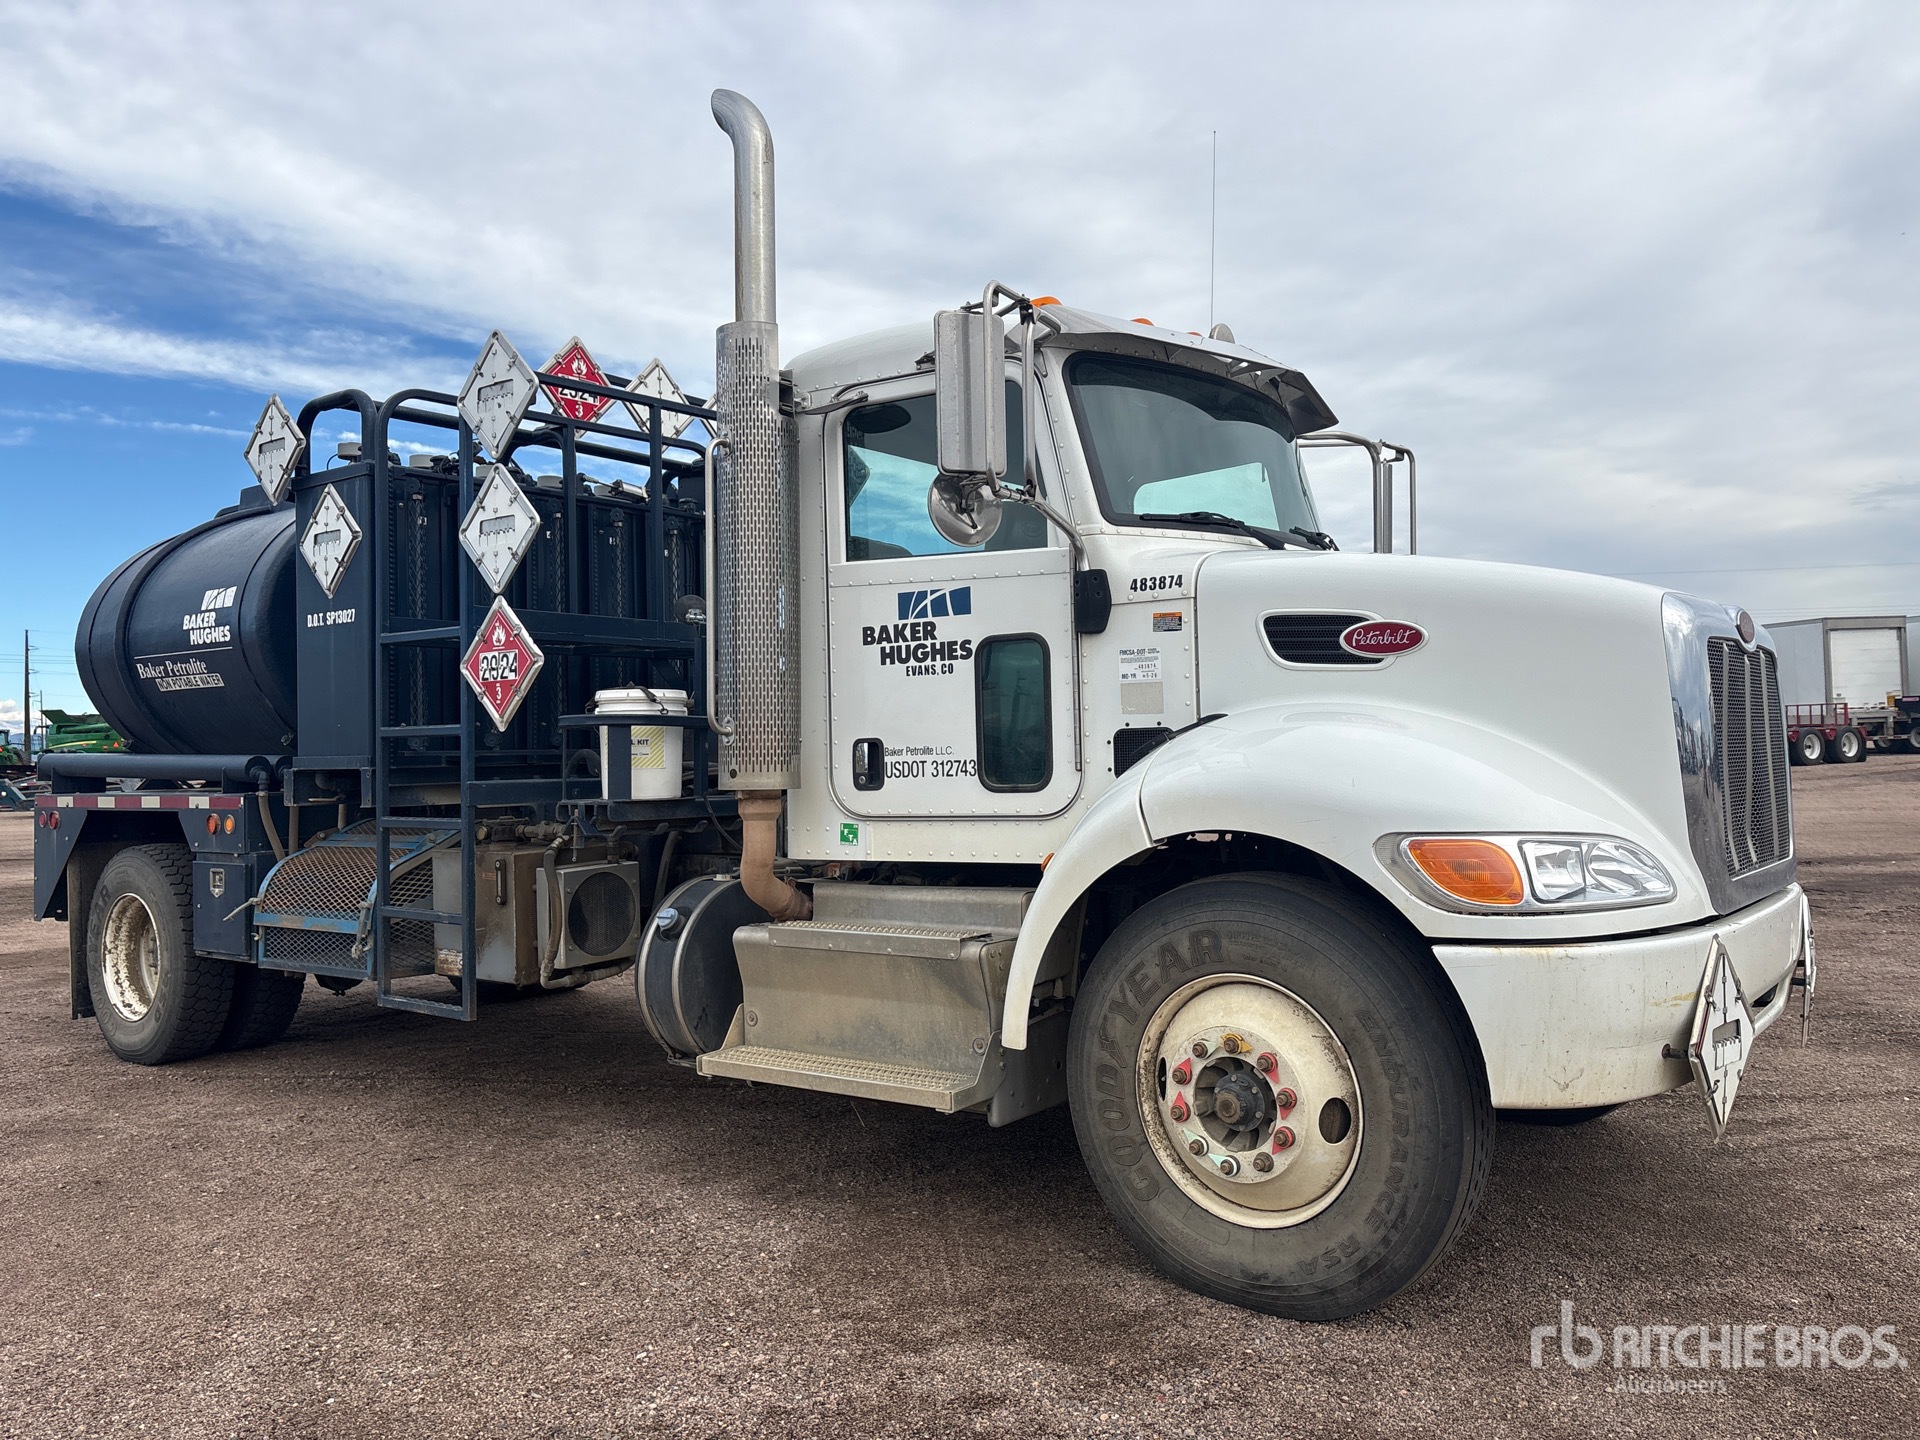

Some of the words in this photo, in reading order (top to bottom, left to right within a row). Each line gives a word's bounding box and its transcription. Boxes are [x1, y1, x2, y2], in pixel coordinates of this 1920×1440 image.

[575, 404, 583, 418] 3
[1130, 574, 1183, 593] 483874
[183, 611, 216, 630] BAKER
[326, 608, 356, 625] SP13027
[190, 625, 231, 645] HUGHES
[862, 621, 938, 646] BAKER
[1352, 628, 1416, 647] Peterbilt
[880, 639, 973, 666] HUGHES
[136, 662, 165, 679] Baker
[165, 658, 208, 676] Petrolite
[481, 653, 518, 682] 2924
[158, 679, 173, 690] NON
[172, 677, 201, 689] POTABLE
[201, 674, 223, 687] WATER
[496, 687, 502, 700] 3
[885, 747, 904, 757] Baker
[906, 746, 934, 756] Petrolite
[885, 761, 928, 778] USDOT
[931, 759, 977, 777] 312743
[1096, 929, 1224, 1202] GOODYEAR
[1355, 1008, 1411, 1234] ENDURANCE
[1297, 1234, 1362, 1276] RSA
